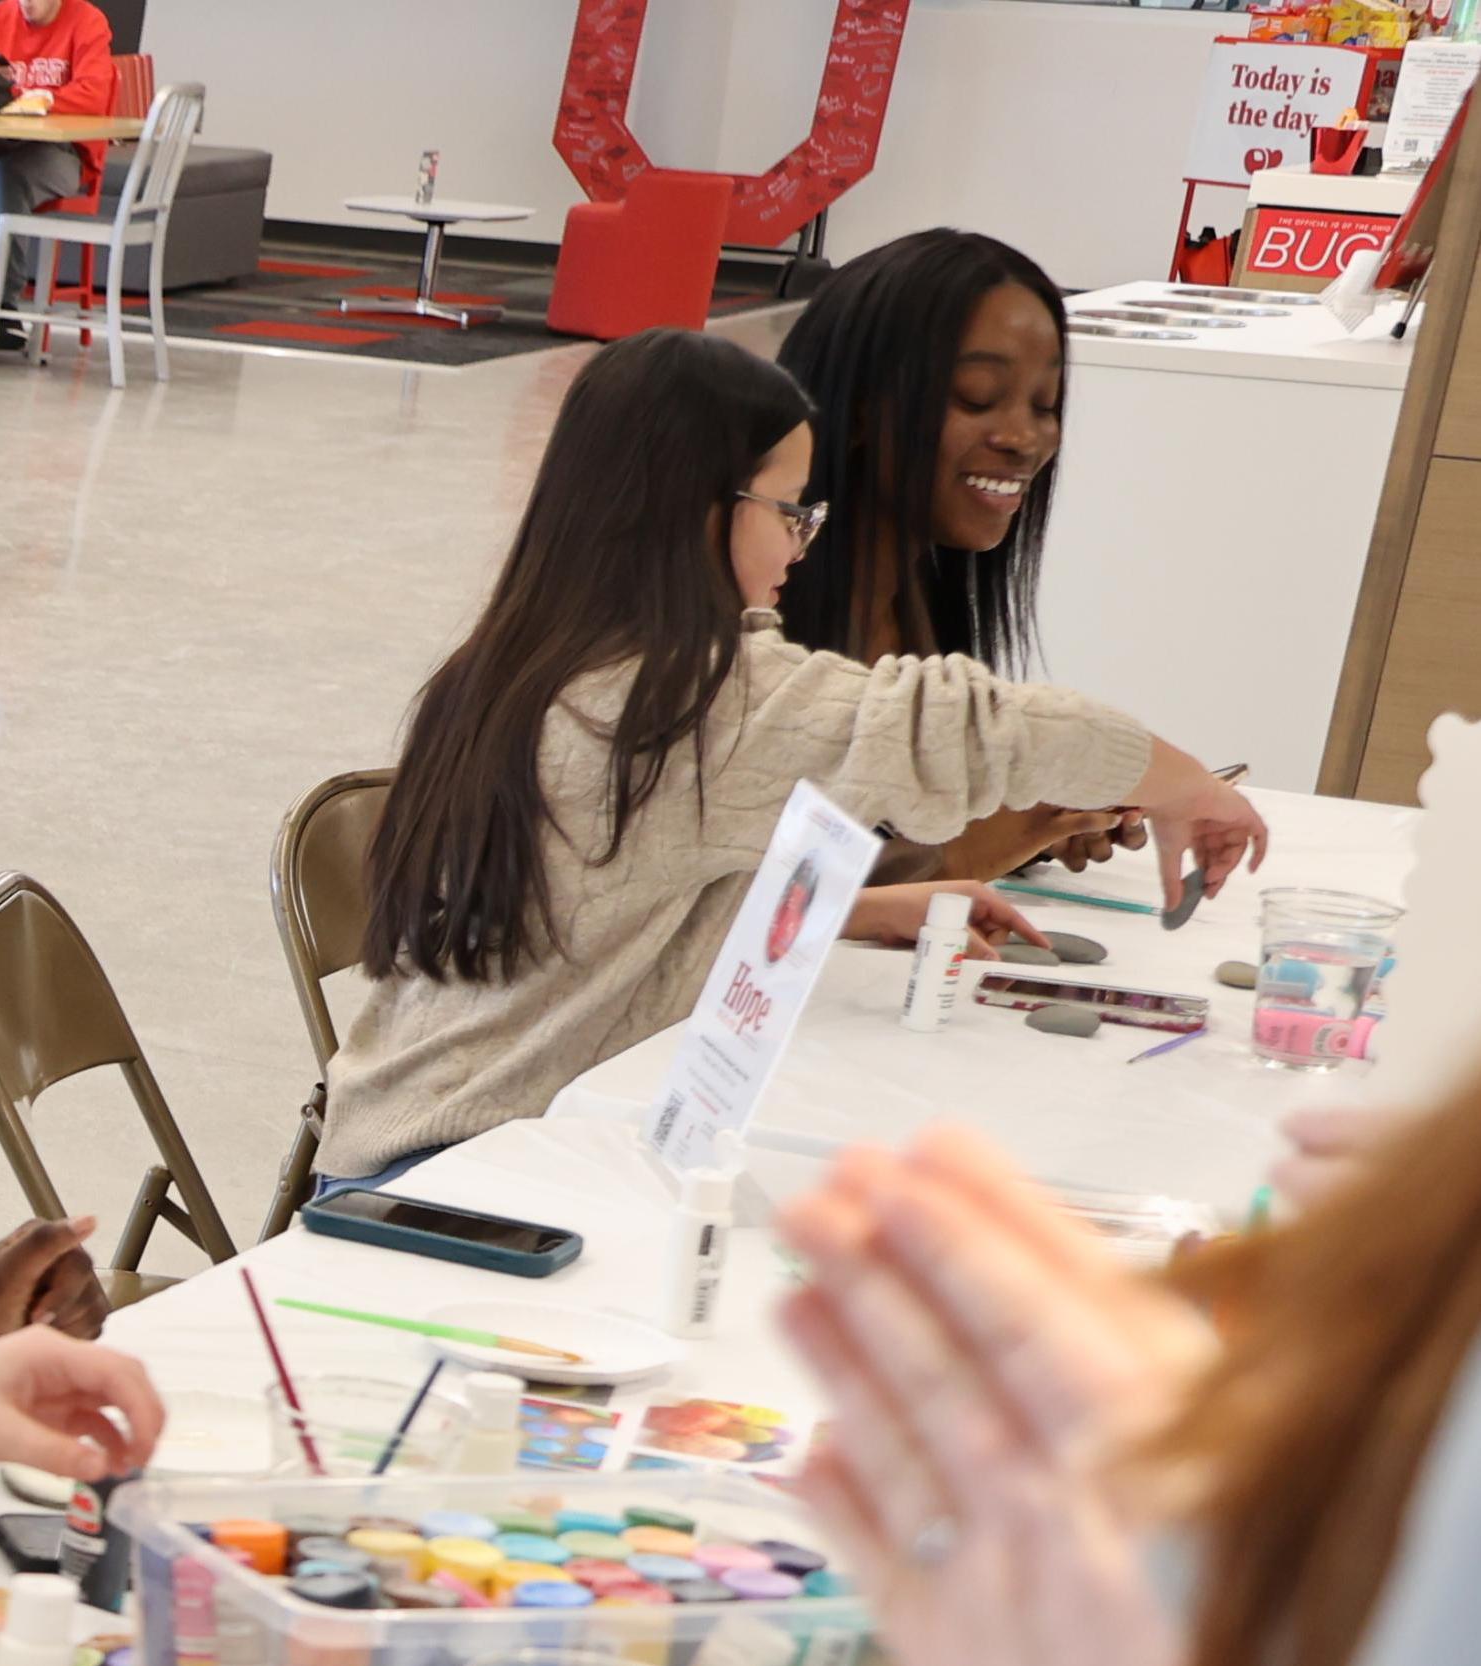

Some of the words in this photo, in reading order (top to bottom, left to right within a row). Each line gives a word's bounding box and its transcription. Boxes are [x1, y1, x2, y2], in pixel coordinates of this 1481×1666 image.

[1231, 63, 1305, 99] Today
[1309, 67, 1331, 95] is
[1227, 100, 1267, 127] the
[1273, 104, 1317, 138] day
[1253, 226, 1391, 272] BUC
[722, 962, 772, 1035] Hope
